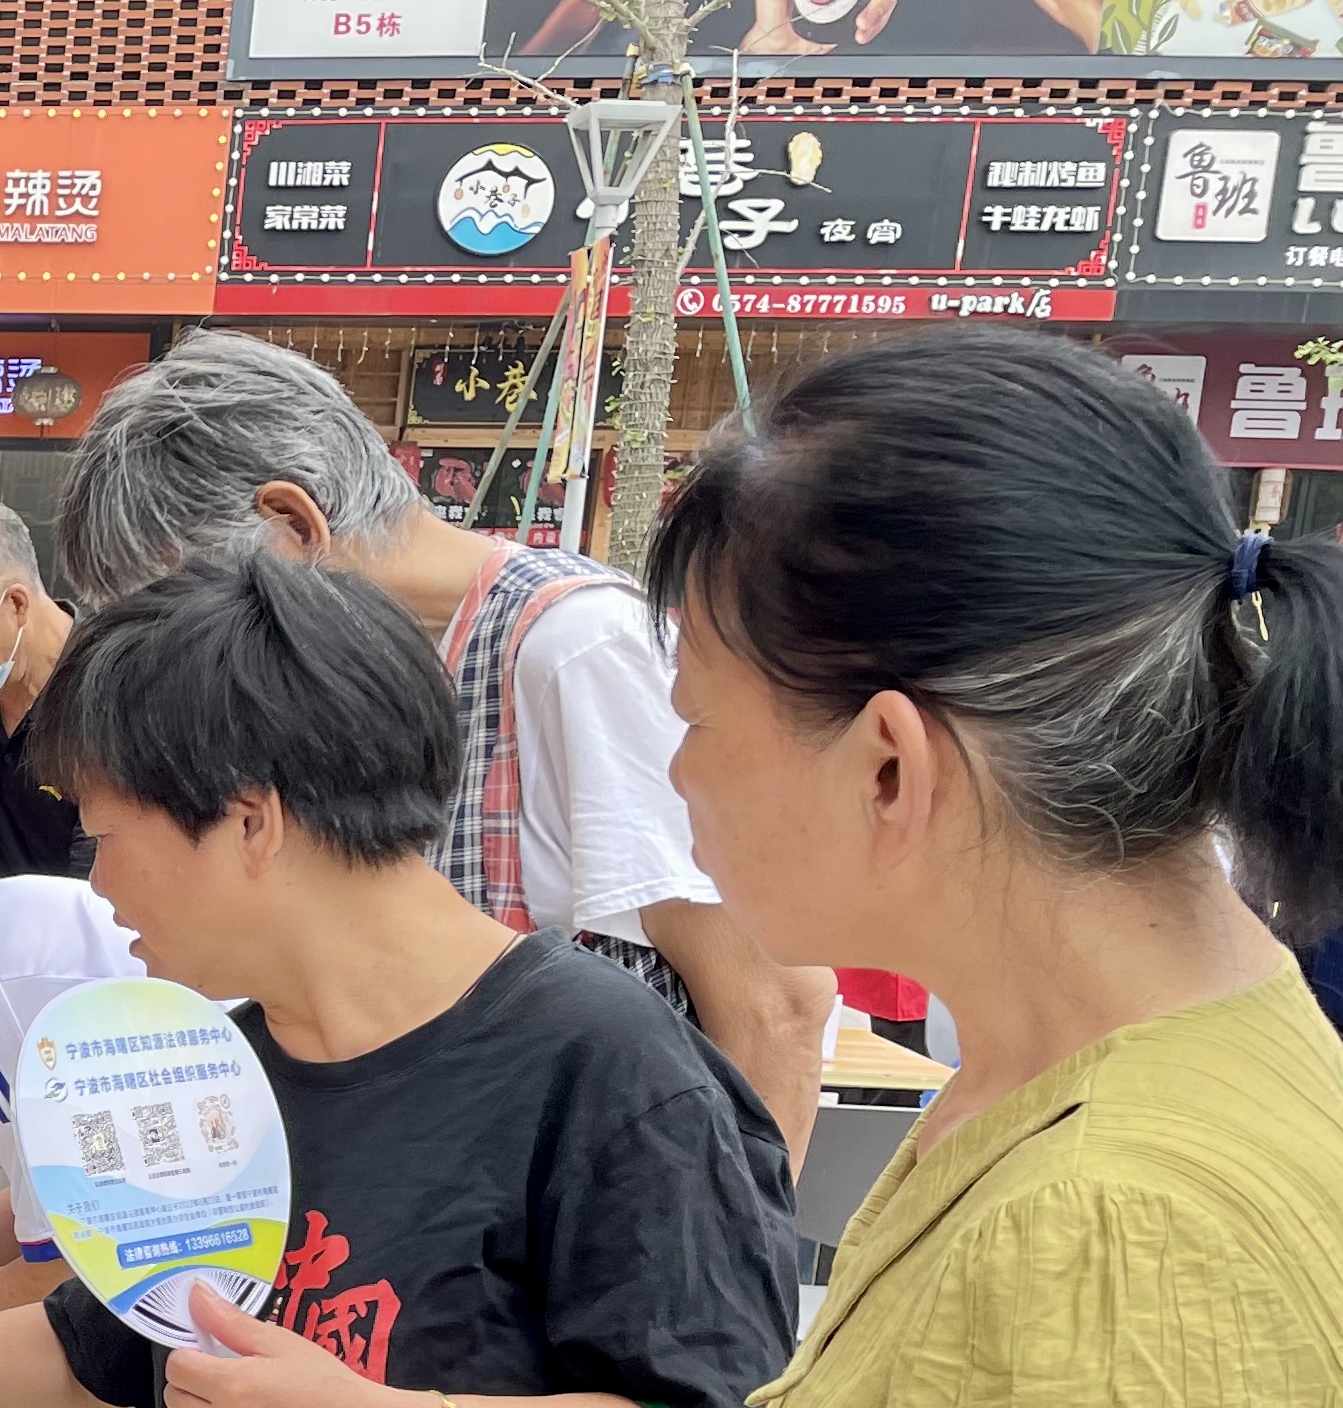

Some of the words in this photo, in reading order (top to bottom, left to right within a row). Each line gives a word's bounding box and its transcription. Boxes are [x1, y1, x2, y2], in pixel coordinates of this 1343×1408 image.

[333, 13, 402, 37] B5栋
[267, 160, 352, 188] 川湘菜
[986, 161, 1107, 188] 秘制烤鱼
[263, 204, 347, 231] 家常菜
[982, 205, 1102, 232] 牛蛙龙虾
[819, 218, 904, 245] 夜宵
[711, 294, 907, 315] 0574-87771595
